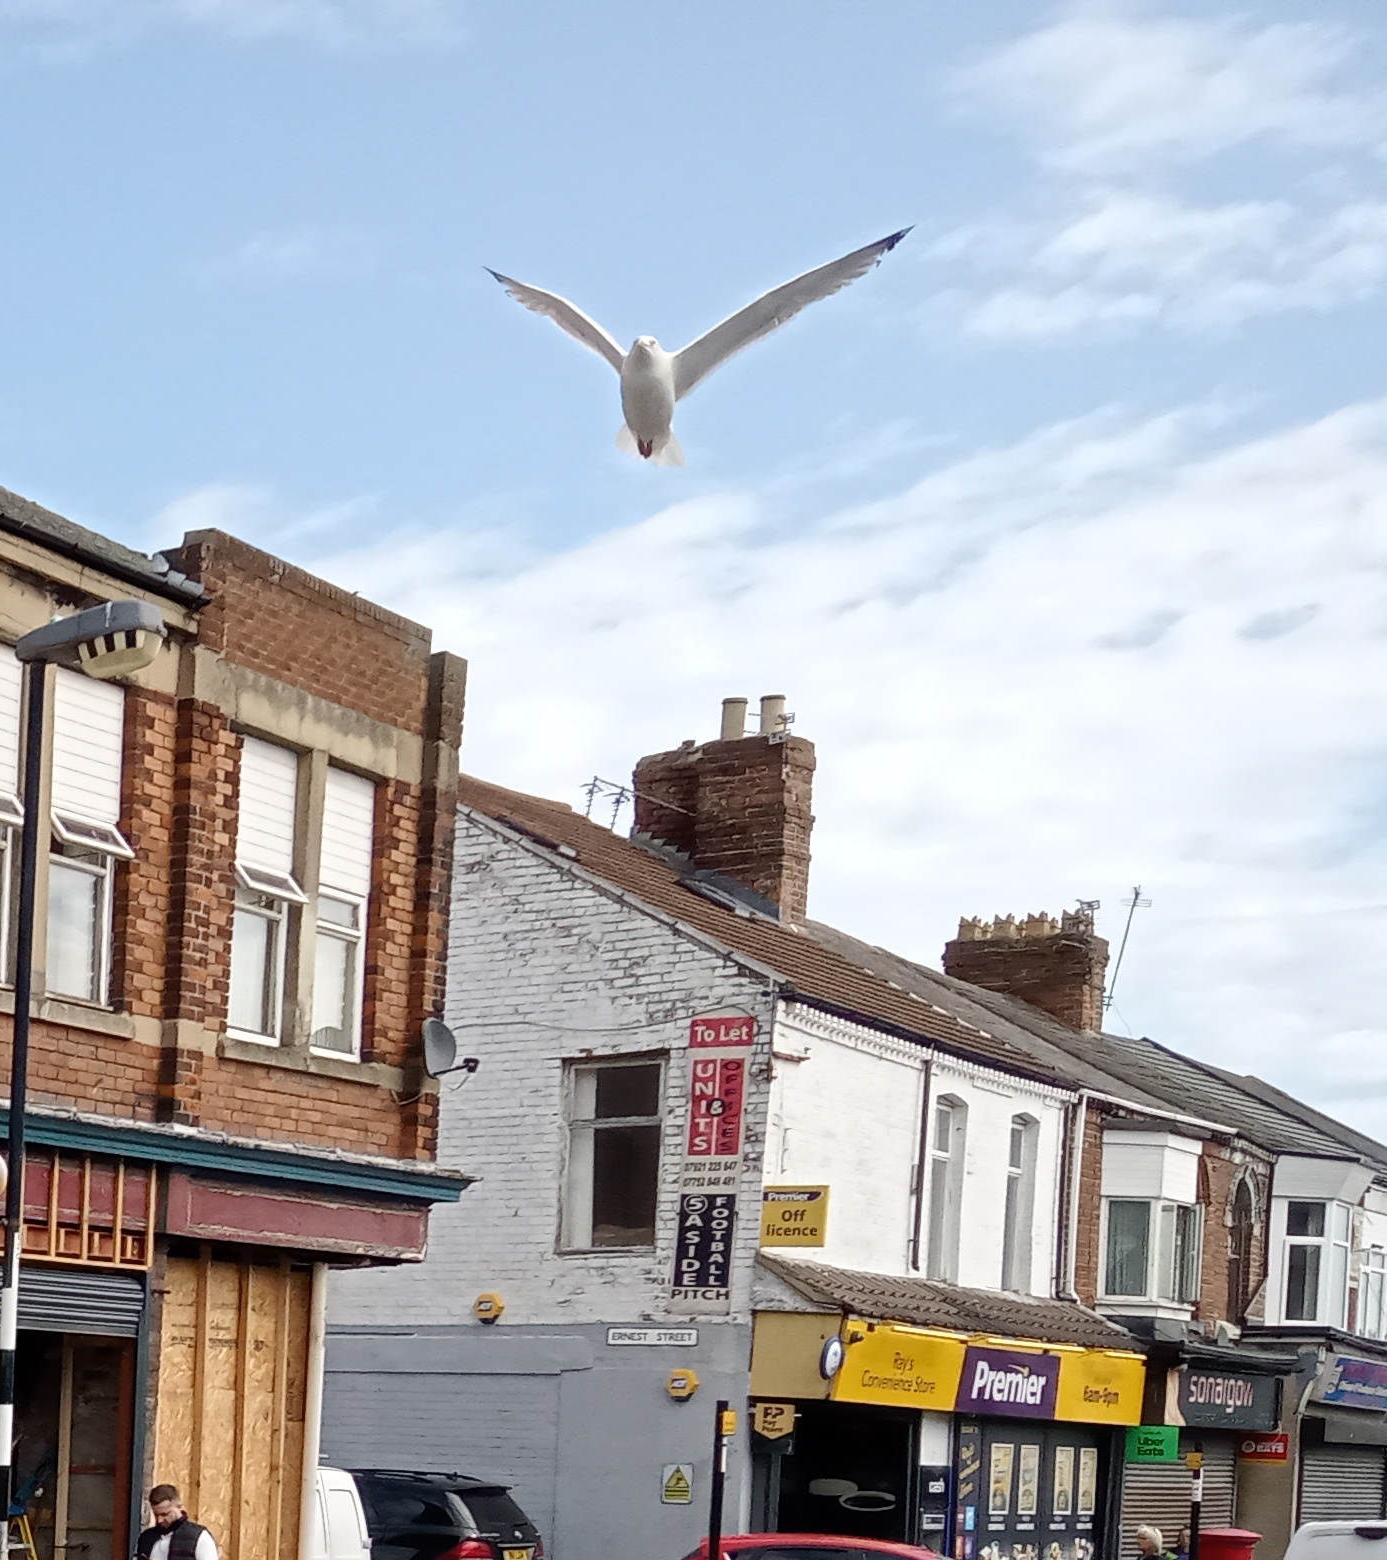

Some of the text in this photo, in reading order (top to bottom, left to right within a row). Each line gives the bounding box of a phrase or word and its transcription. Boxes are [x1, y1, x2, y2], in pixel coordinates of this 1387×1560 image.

[694, 1024, 750, 1042] To Let
[692, 1062, 714, 1151] UNITS
[709, 1099, 724, 1116] &
[781, 1208, 807, 1222] Off
[765, 1224, 818, 1236] licence
[707, 1196, 730, 1286] FOOTBALL
[670, 1289, 730, 1300] PITCH
[611, 1331, 693, 1342] ERNEST STREET
[861, 1369, 936, 1394] Convenience Store
[970, 1360, 1047, 1405] Premier
[1137, 1436, 1164, 1446] Uber
[1137, 1446, 1164, 1456] Eats
